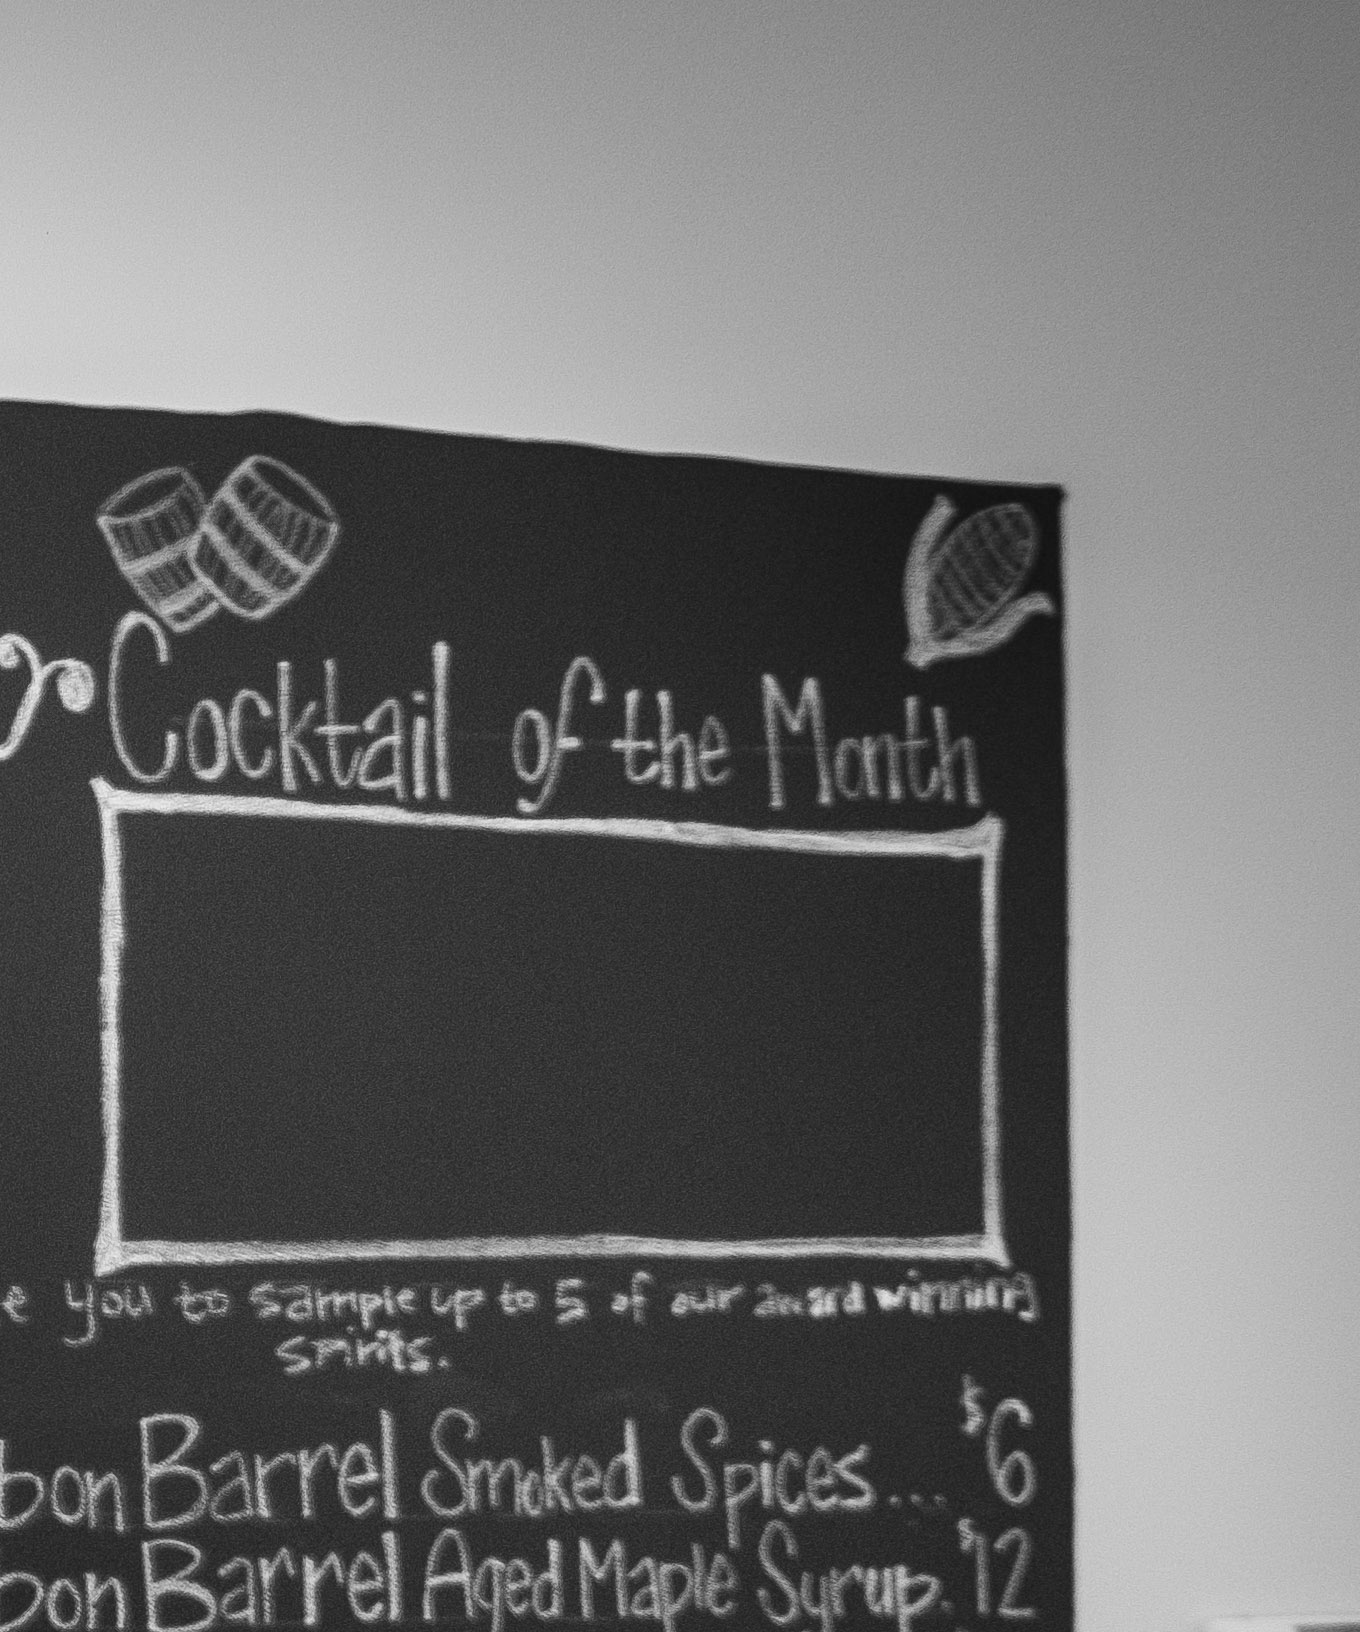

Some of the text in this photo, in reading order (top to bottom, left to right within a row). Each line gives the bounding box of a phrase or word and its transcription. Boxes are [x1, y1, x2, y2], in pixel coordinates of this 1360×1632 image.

[108, 610, 981, 813] Cocktail of the Month
[63, 1281, 154, 1346] you
[182, 1283, 231, 1324] to
[249, 1281, 418, 1331] sample
[432, 1287, 485, 1331] up
[500, 1280, 538, 1315] to
[556, 1277, 588, 1325] 5
[610, 1272, 652, 1323] of
[671, 1286, 745, 1315] our
[141, 1408, 397, 1529] Barrel
[421, 1407, 640, 1518] Smoked
[961, 1374, 1037, 1506] $6
